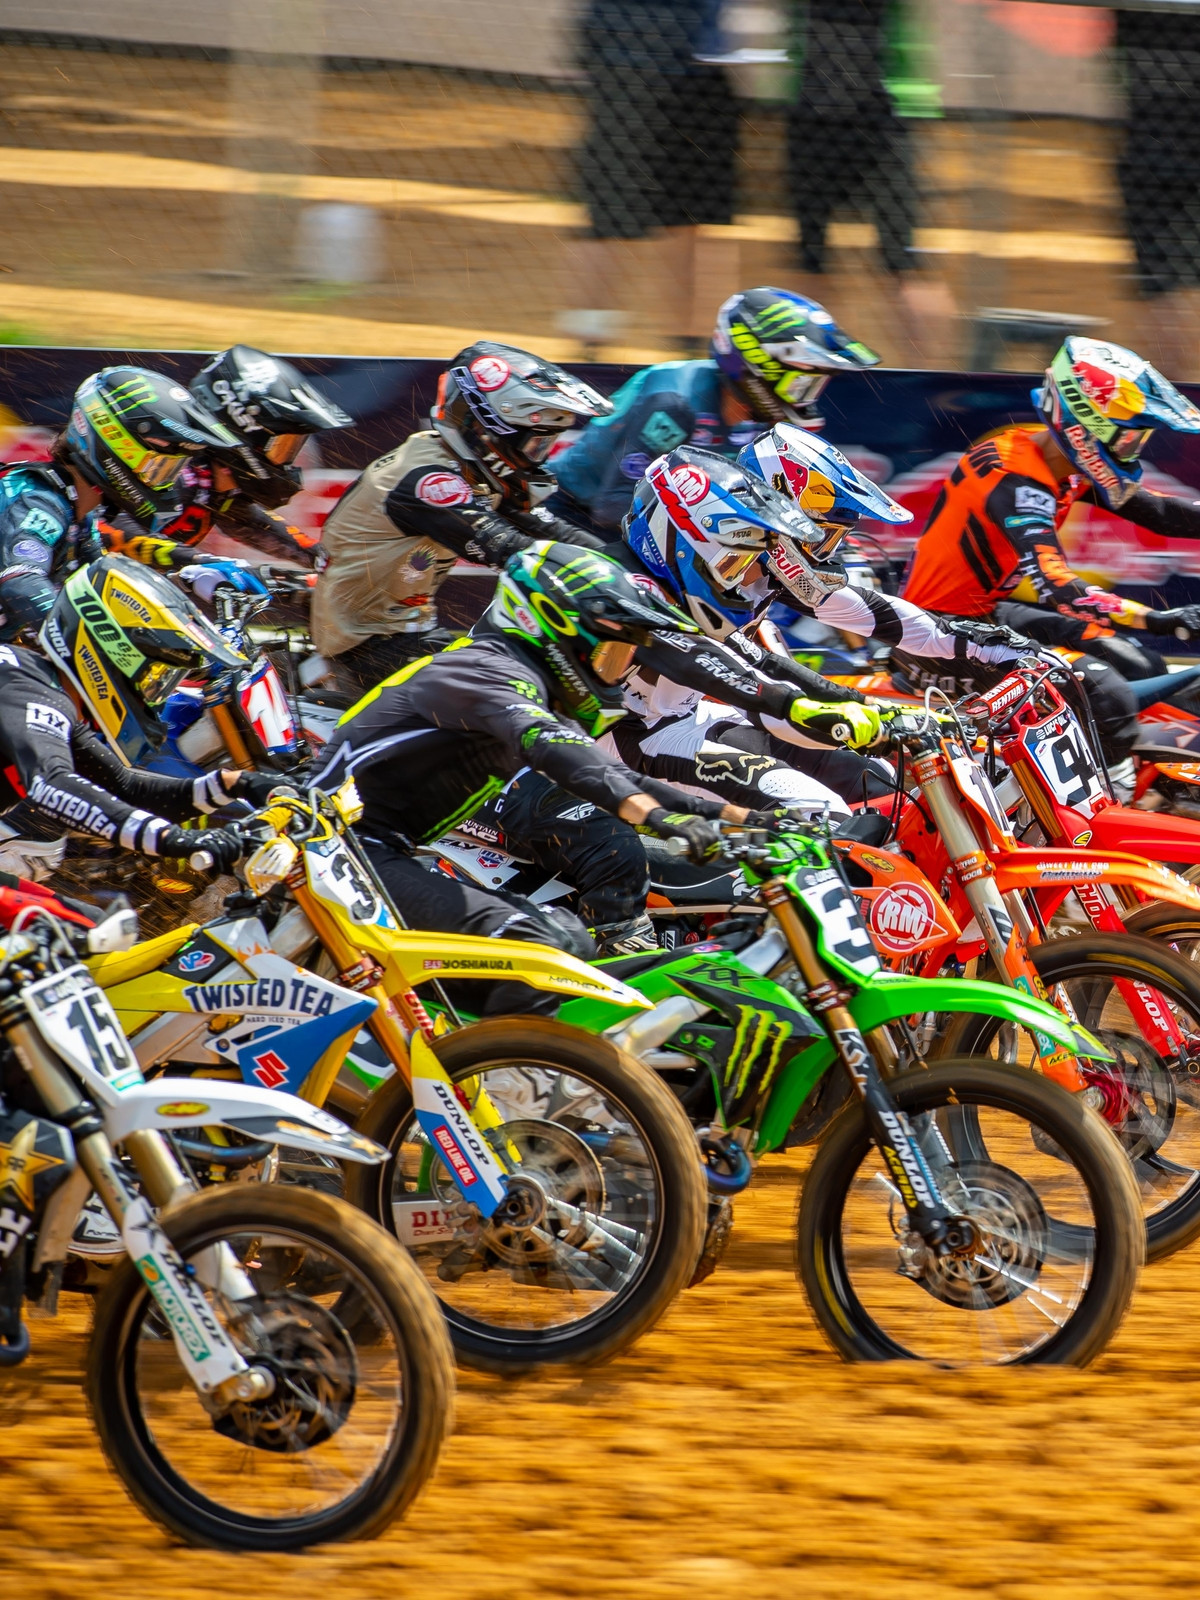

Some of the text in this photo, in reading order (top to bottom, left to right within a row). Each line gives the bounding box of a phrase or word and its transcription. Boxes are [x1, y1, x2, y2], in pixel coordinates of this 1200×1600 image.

[1064, 425, 1119, 489] Red Bull
[772, 543, 805, 580] Bull
[109, 587, 152, 624] TWISTED TEA
[47, 617, 72, 659] THOR
[78, 644, 104, 686] TWISTED
[991, 682, 1026, 713] RENTHAL
[30, 774, 119, 841] TWISTED TEA
[822, 886, 878, 963] 3
[878, 894, 929, 941] RMC
[442, 960, 513, 971] YOSHIMURA
[184, 977, 335, 1017] TWISTED TEA
[66, 992, 132, 1078] 15
[433, 1084, 490, 1166] DUNLOP
[435, 1129, 475, 1184] RED LINE OIL
[878, 1110, 936, 1209] DUNLOP
[152, 1280, 210, 1358] MOTOREX
